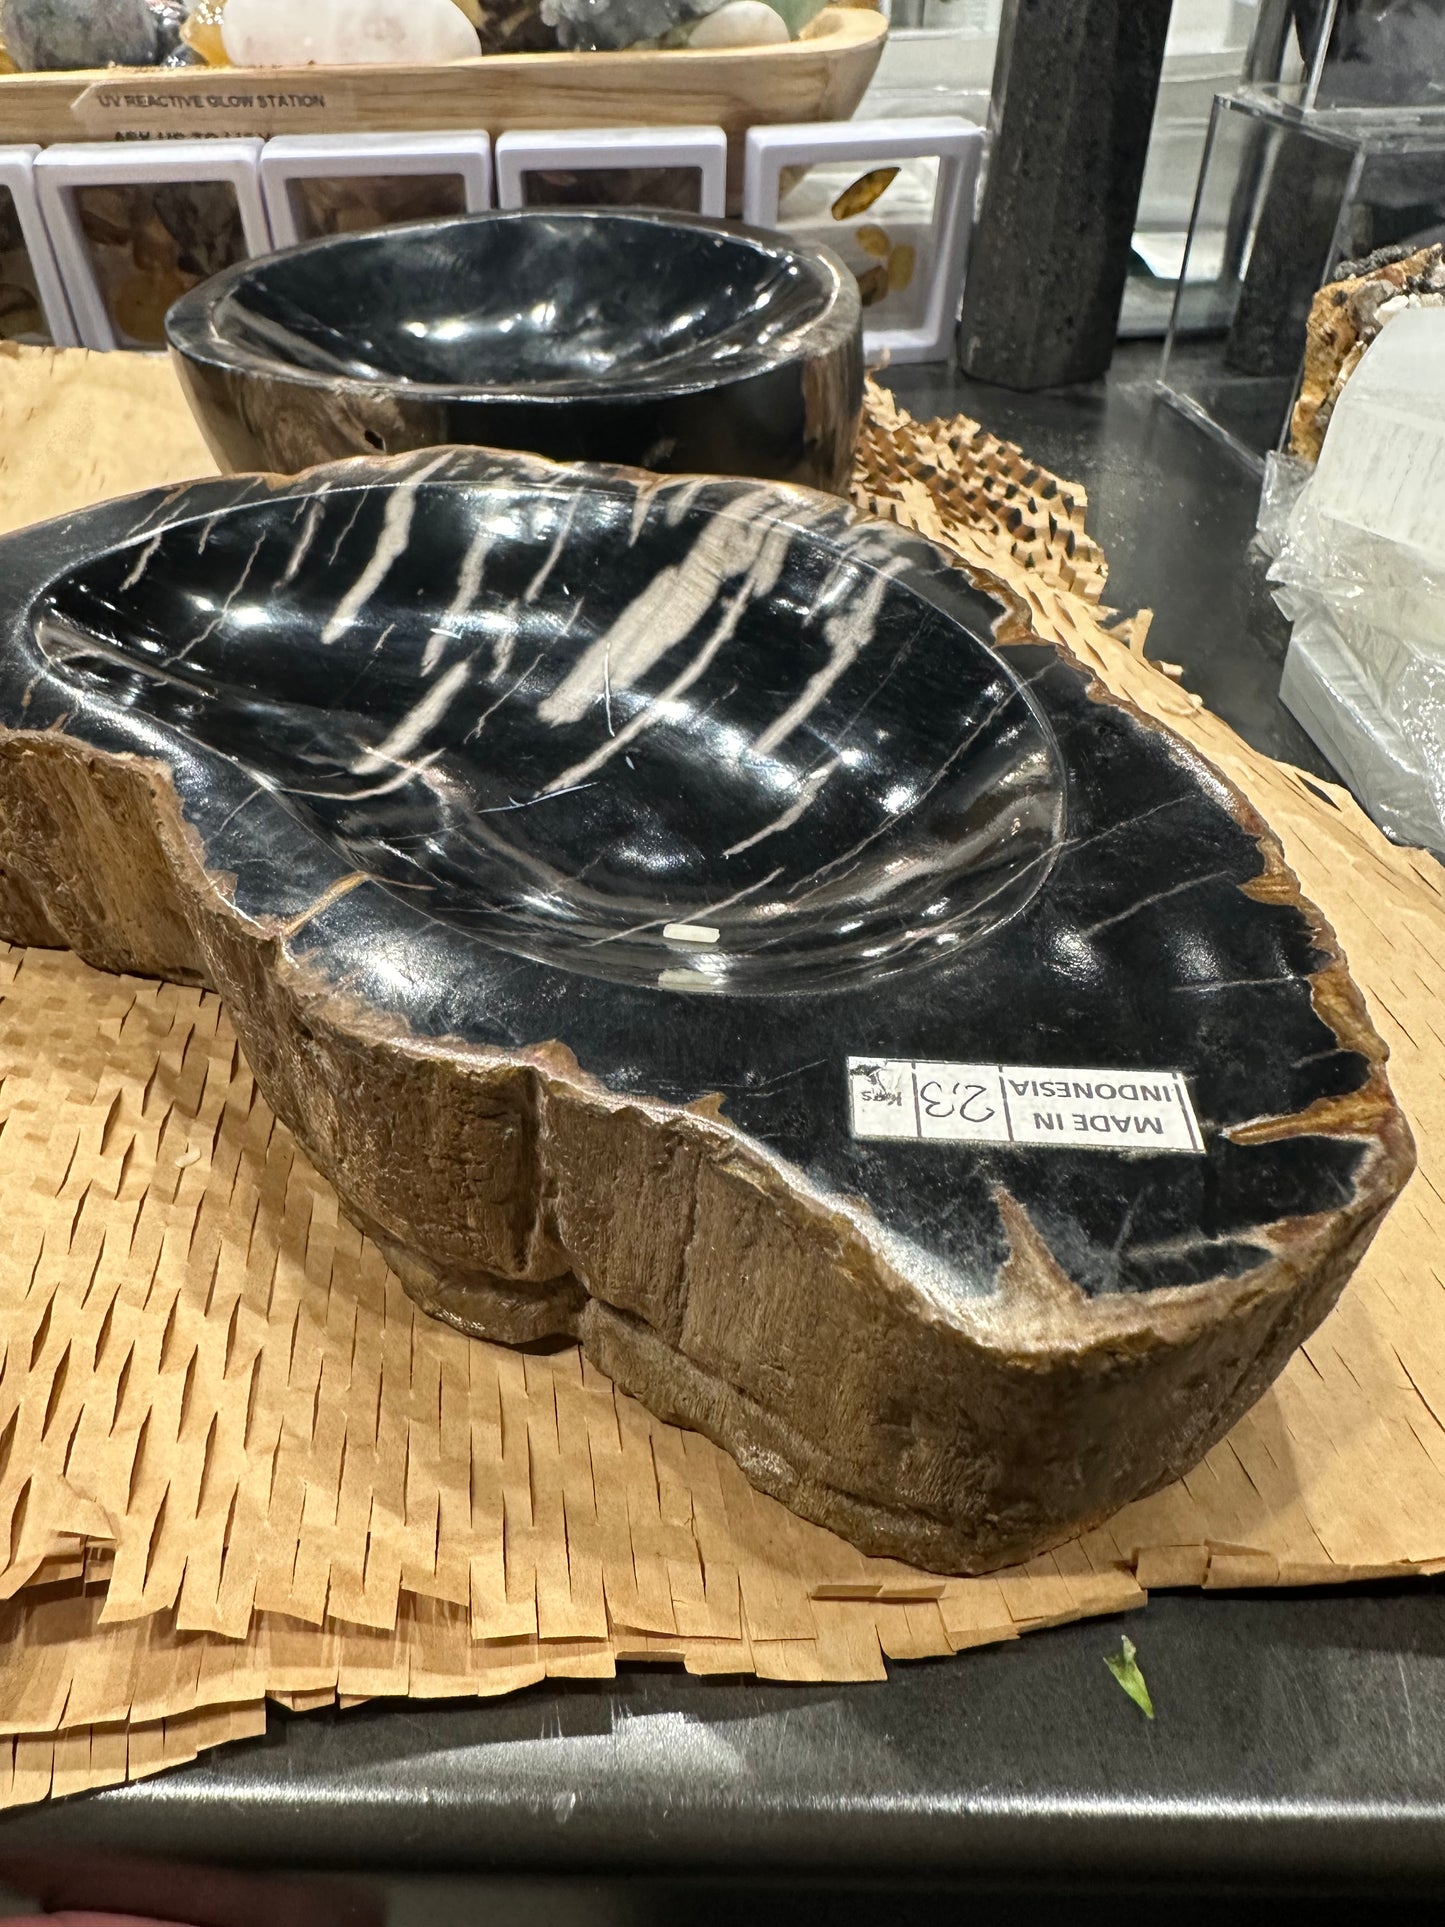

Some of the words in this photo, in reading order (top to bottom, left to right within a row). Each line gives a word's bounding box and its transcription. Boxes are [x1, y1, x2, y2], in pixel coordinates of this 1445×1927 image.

[99, 95, 121, 108] UV
[123, 95, 204, 109] REACTIVE
[206, 95, 252, 108] GLOW
[259, 95, 325, 109] STATION
[1007, 1078, 1173, 1103] INDONESIA
[1035, 1112, 1064, 1131] IN
[1074, 1113, 1165, 1135] MADE
